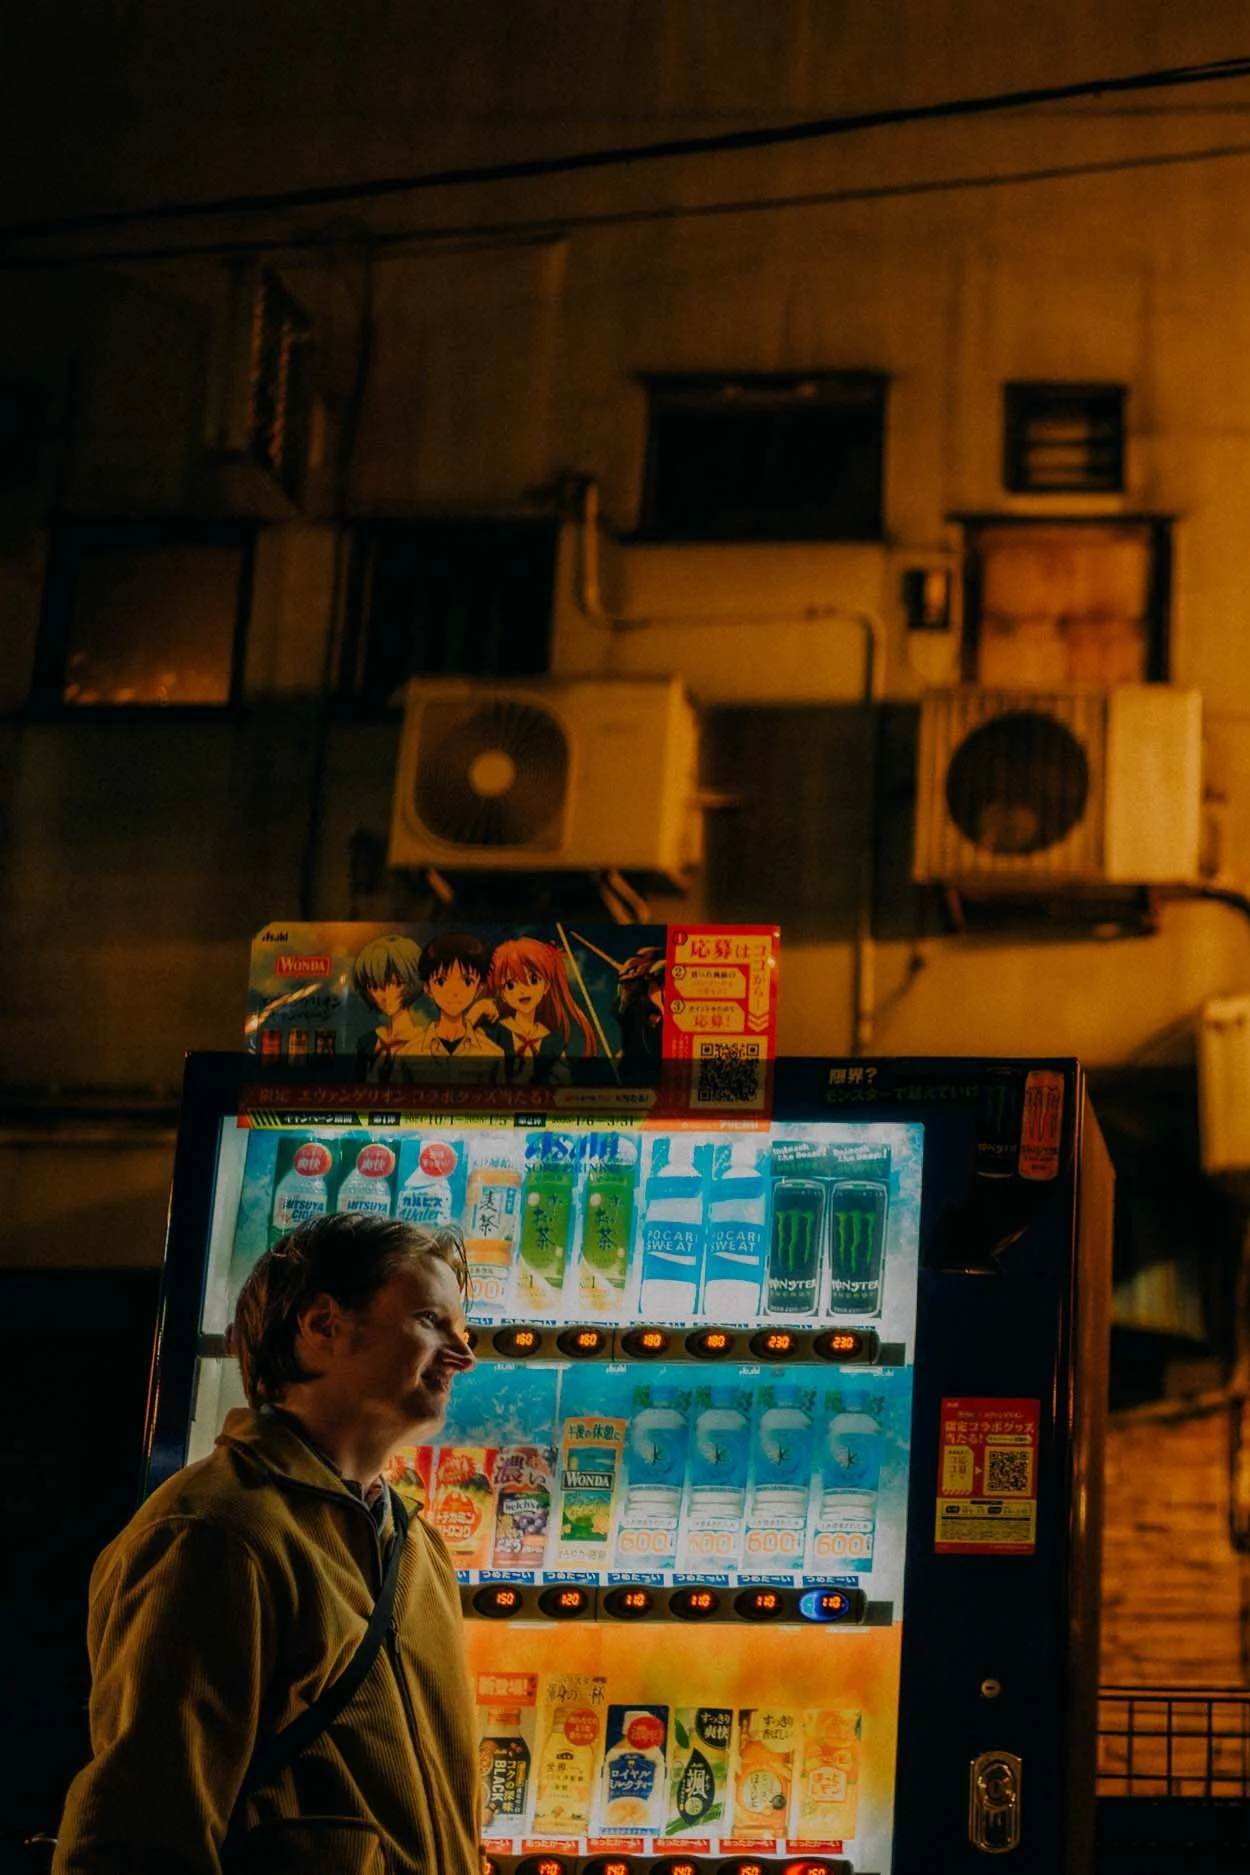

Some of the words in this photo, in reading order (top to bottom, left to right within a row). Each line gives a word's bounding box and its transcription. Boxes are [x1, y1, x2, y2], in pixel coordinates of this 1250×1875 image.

[280, 958, 326, 972] WONDA
[828, 1067, 877, 1085] 限界?
[768, 1335, 790, 1348] 230
[832, 1336, 854, 1348] 230
[565, 1471, 610, 1488] WONDA
[561, 1592, 580, 1606] 120
[701, 1713, 730, 1724] すっきり
[704, 1725, 729, 1739] 爽快
[492, 1759, 507, 1802] BLACK
